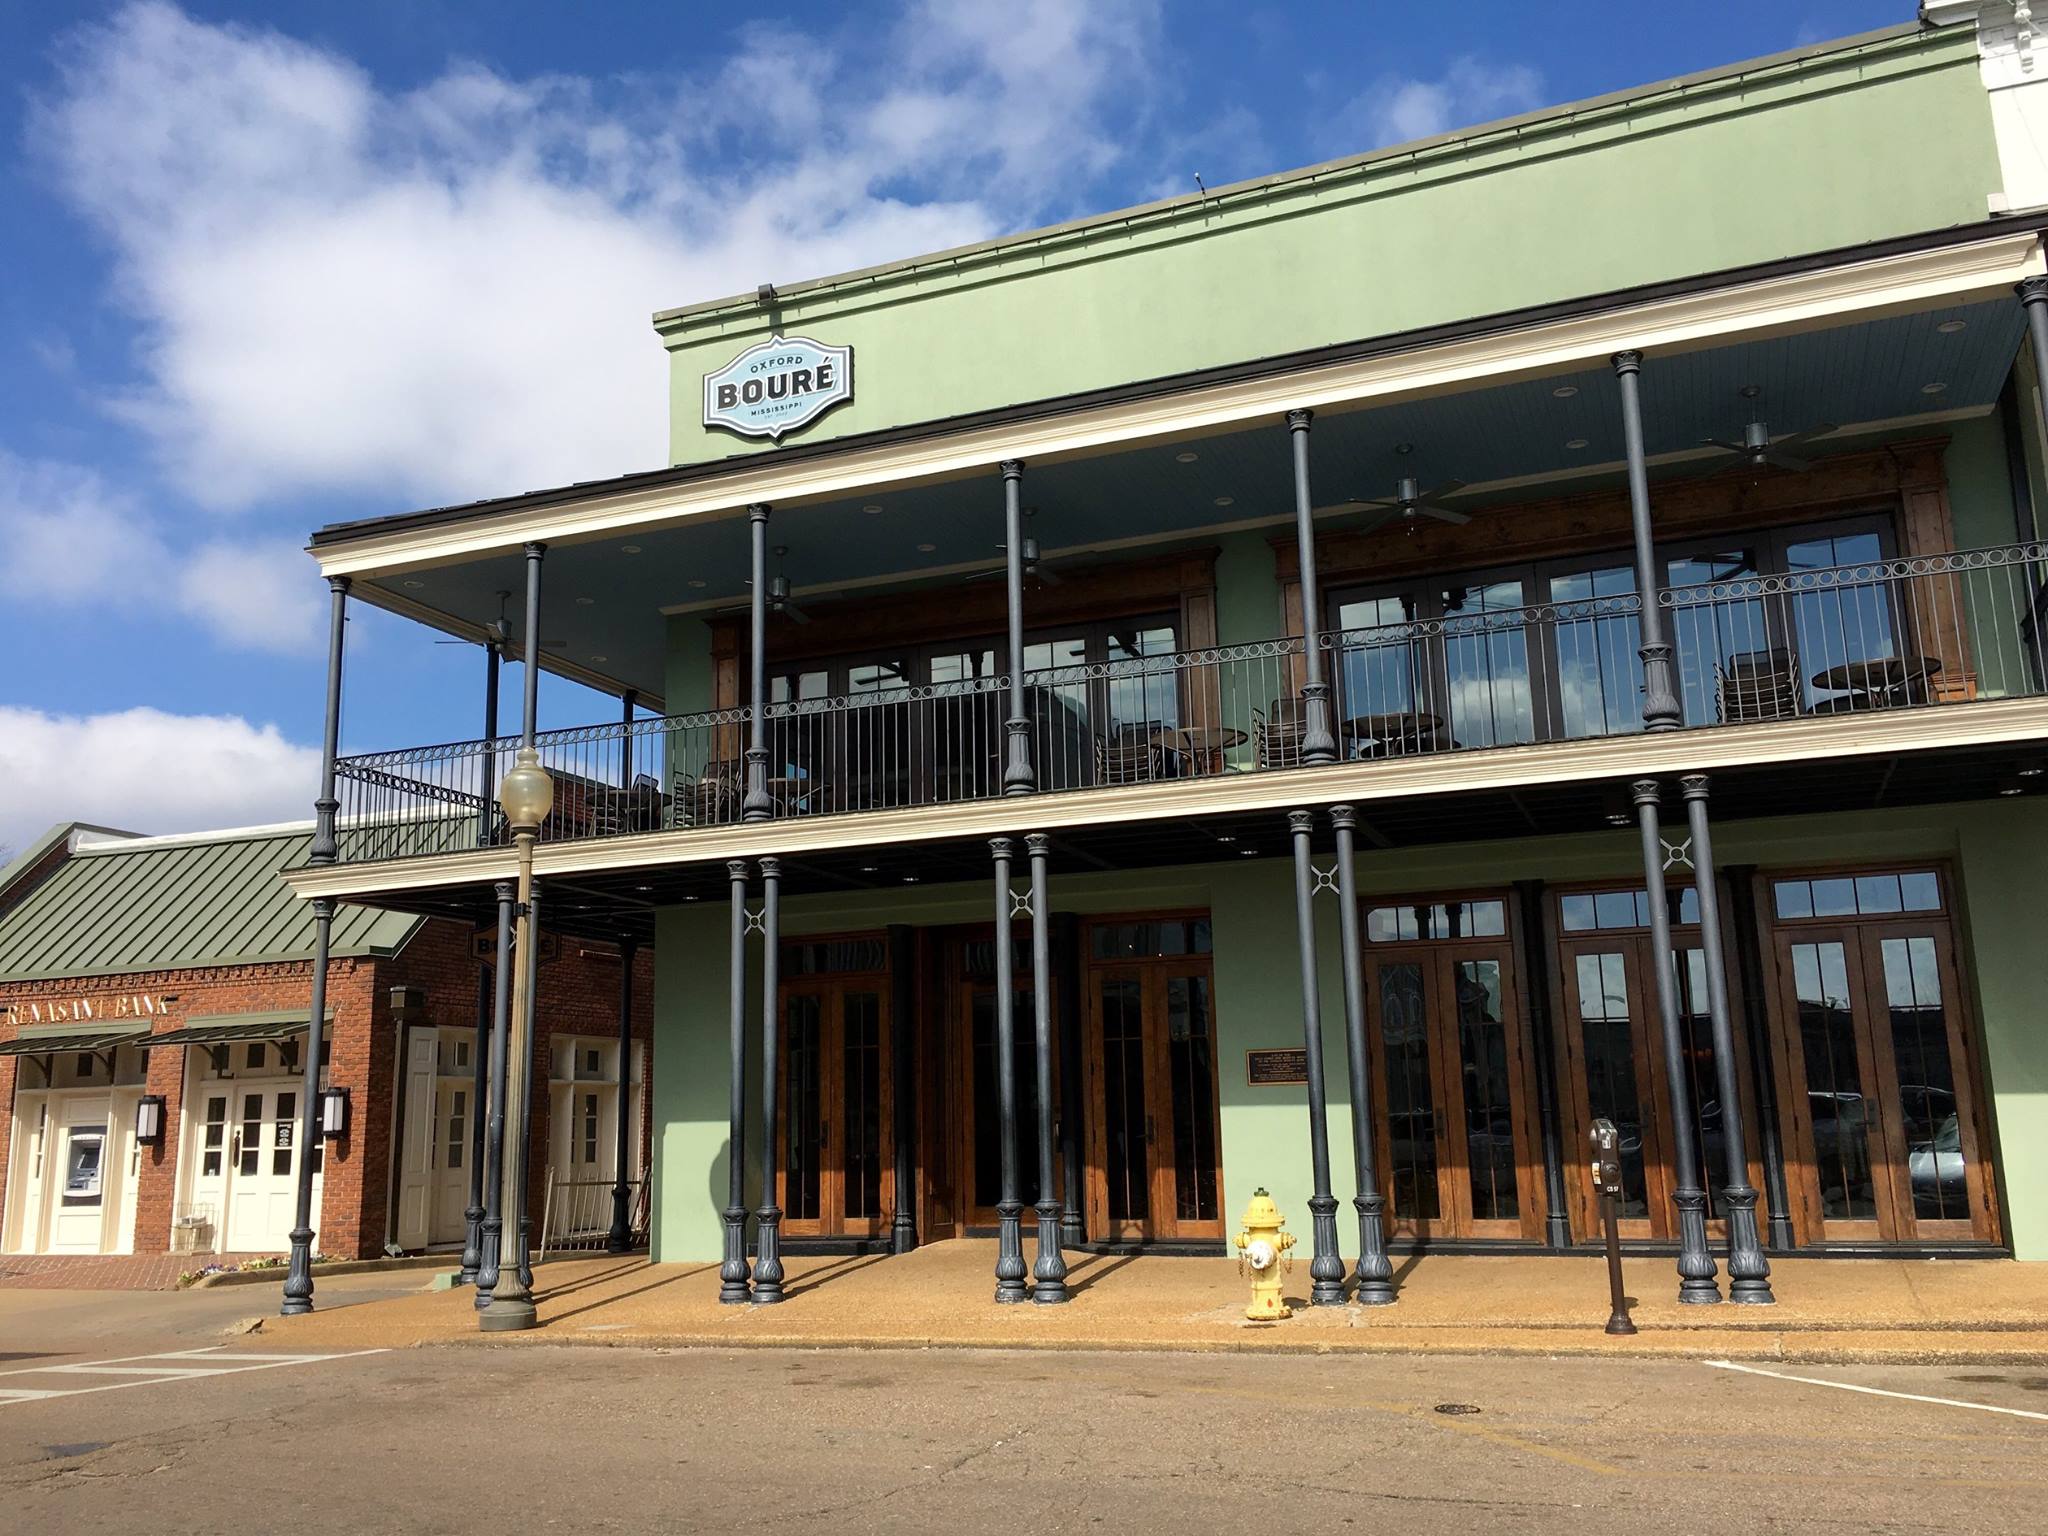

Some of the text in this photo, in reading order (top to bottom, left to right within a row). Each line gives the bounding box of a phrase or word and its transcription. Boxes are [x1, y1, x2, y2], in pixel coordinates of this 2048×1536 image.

[750, 356, 804, 374] OXFORD
[716, 356, 835, 411] BOURÉ
[751, 401, 802, 417] MISSISSIPPI
[6, 994, 168, 1026] RENASANT BANK
